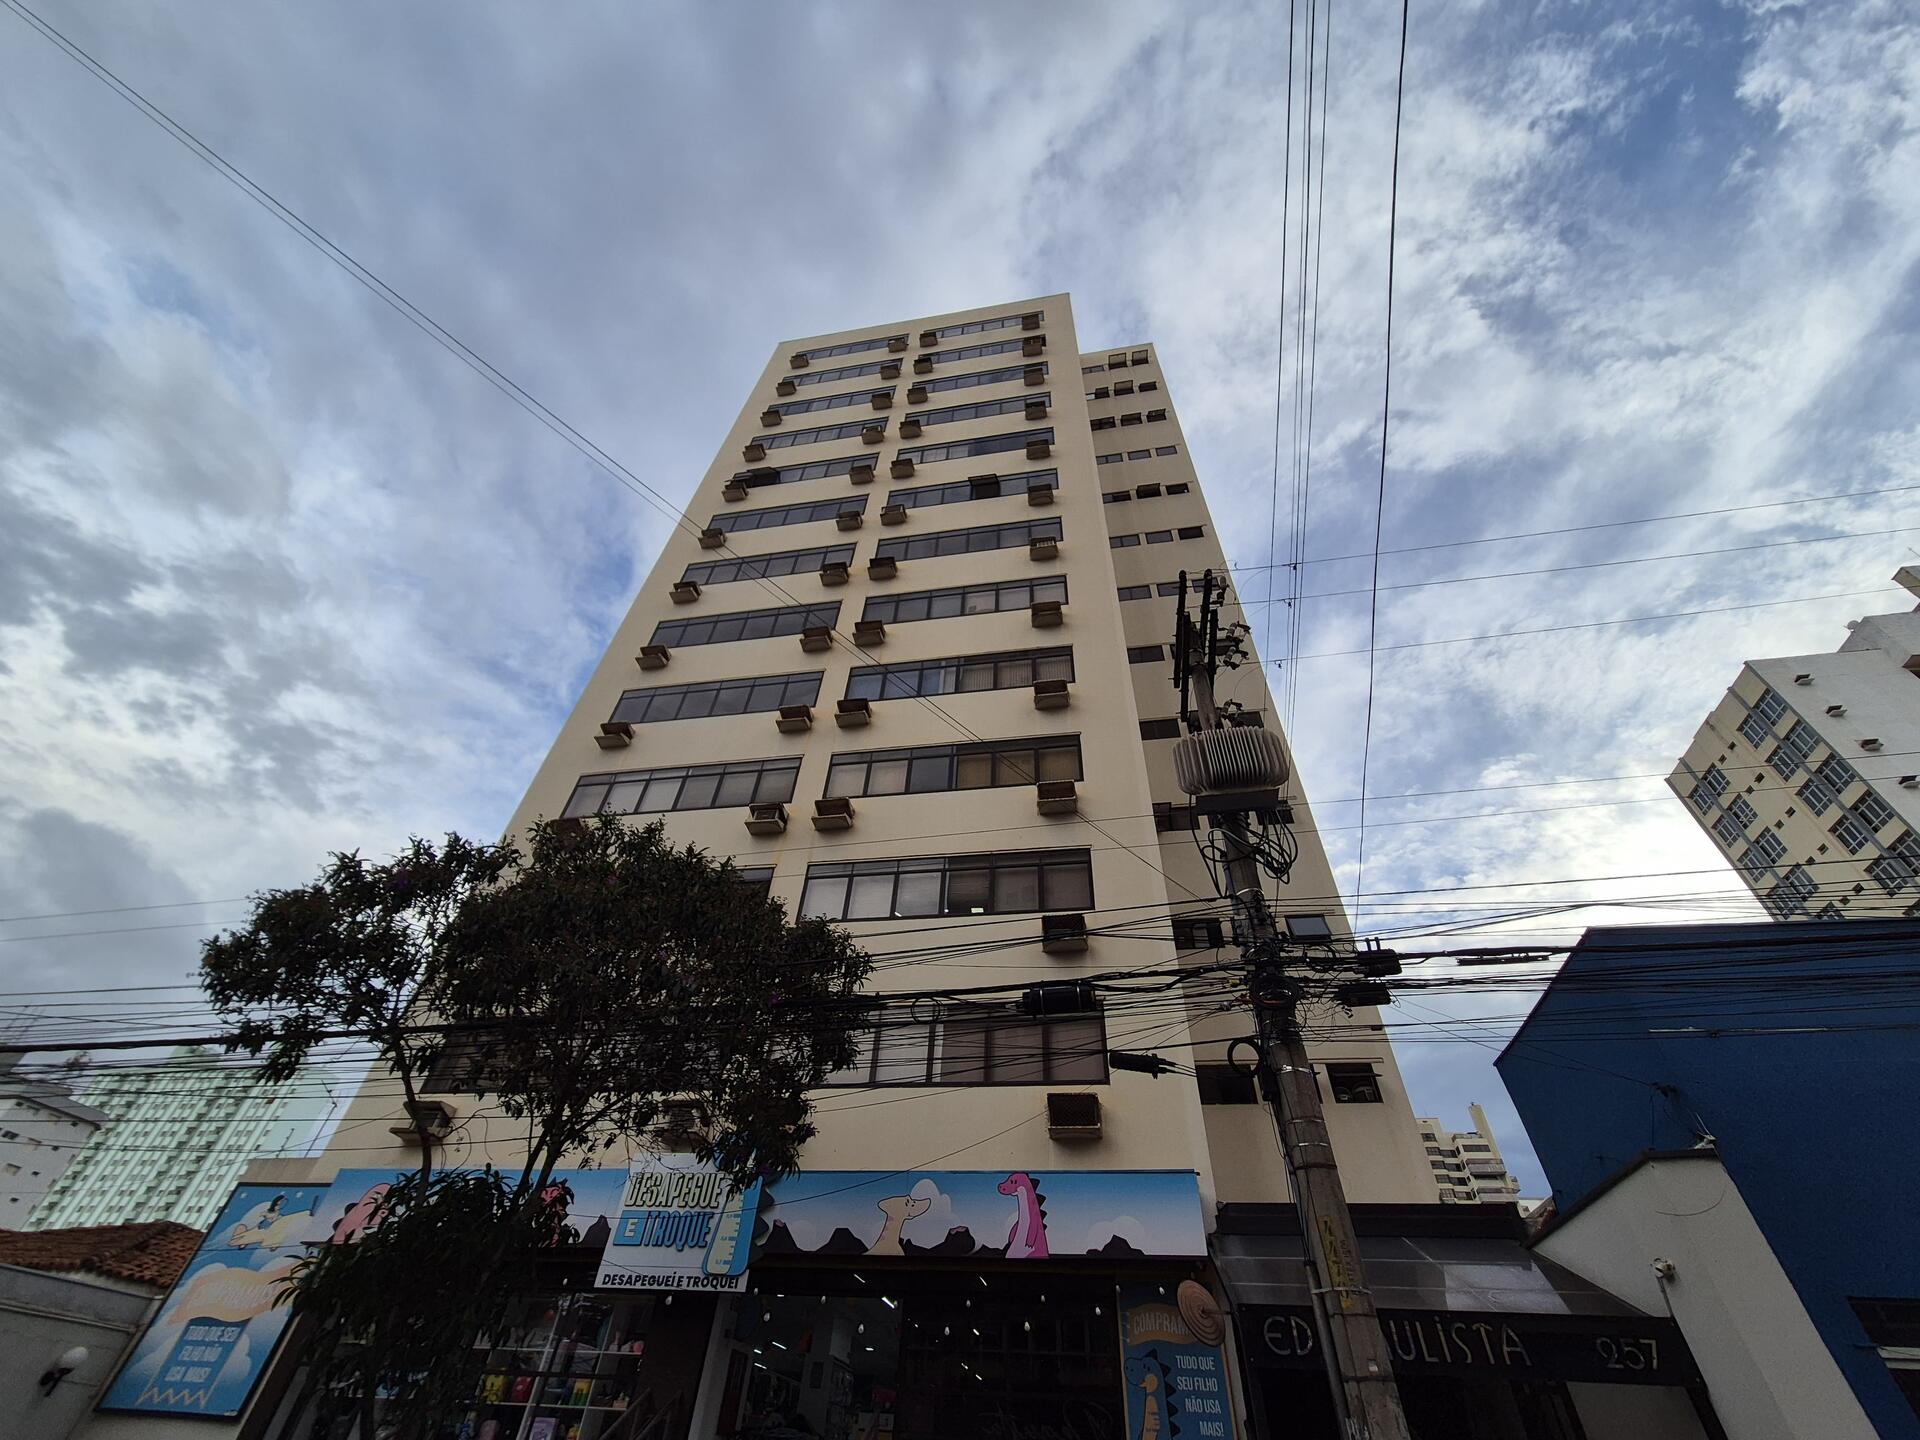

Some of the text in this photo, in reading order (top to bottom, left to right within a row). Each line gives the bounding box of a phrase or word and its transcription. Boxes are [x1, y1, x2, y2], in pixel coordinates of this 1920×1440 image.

[623, 1172, 724, 1208] DESAPEGUE
[624, 1210, 715, 1251] E TROQUE
[676, 1275, 684, 1287] E
[686, 1276, 740, 1290] TROQUEI
[1263, 1314, 1660, 1372] ED ULISTA 257
[1175, 1355, 1216, 1371] TUDO QUE
[1176, 1376, 1218, 1392] SEU FILHO
[1184, 1395, 1222, 1414] NÃO USA
[1199, 1420, 1224, 1437] MAIS!
